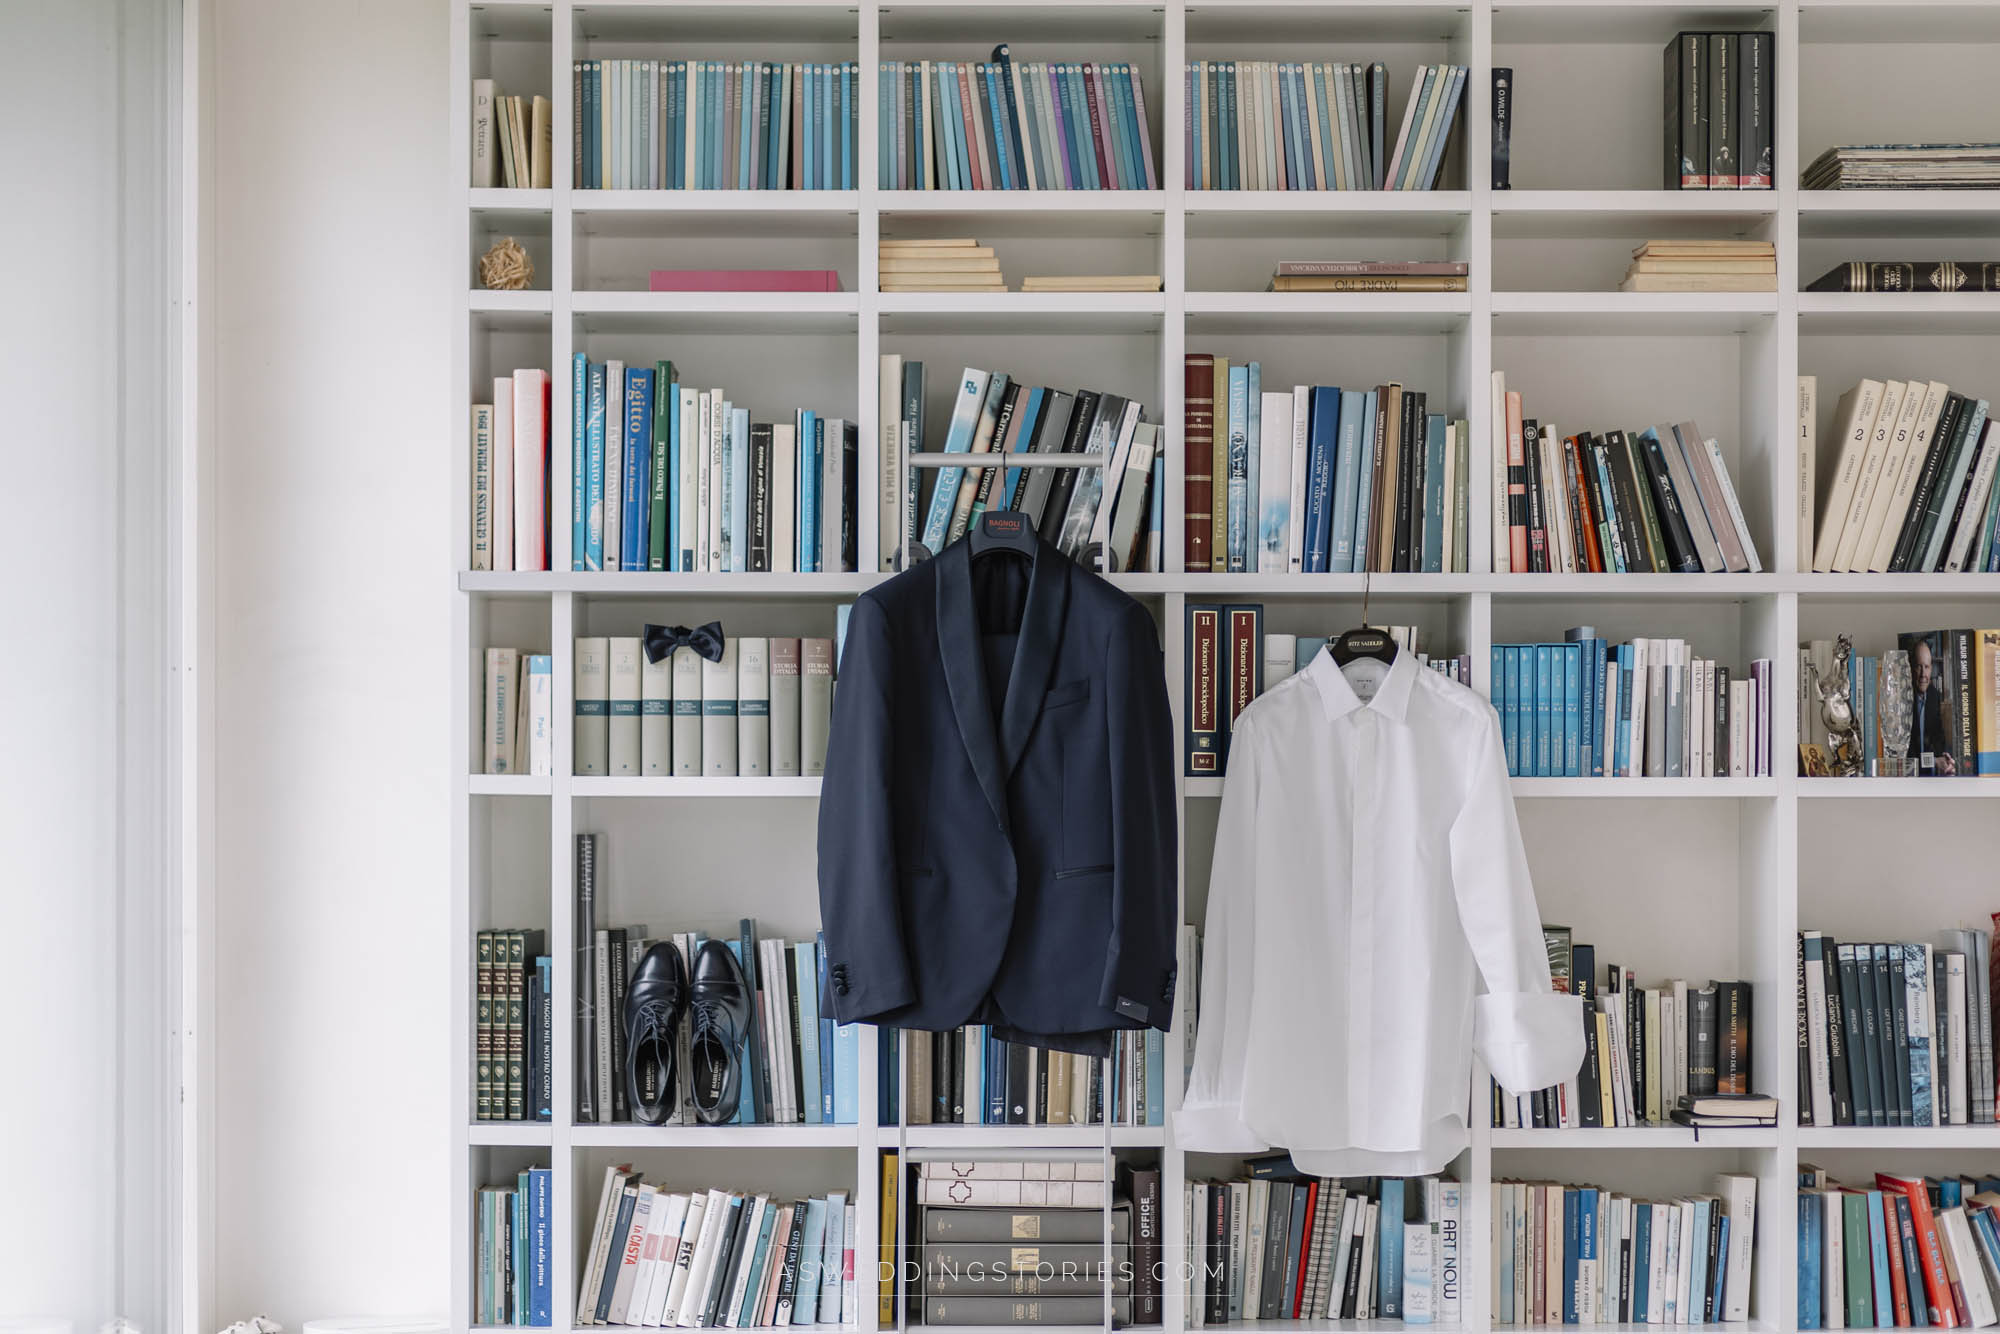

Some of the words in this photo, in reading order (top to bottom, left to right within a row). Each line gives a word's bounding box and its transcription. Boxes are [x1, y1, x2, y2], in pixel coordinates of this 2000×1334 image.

[1086, 82, 1100, 136] MICHELANGELO
[1497, 90, 1506, 119] O.WILDE
[1334, 280, 1356, 292] PIO
[1360, 280, 1399, 292] PADRE
[592, 371, 602, 420] ATLANTE
[628, 377, 648, 433] Egitto
[476, 410, 488, 431] 1994
[713, 403, 722, 428] CORSI
[989, 411, 1010, 455] Carneval
[1801, 425, 1807, 438] 1
[1854, 428, 1864, 441] 2
[1876, 428, 1885, 441] 3
[1897, 429, 1907, 442] 5
[1917, 429, 1926, 442] 4
[476, 433, 488, 473] PRIMATI
[590, 421, 601, 482] ILLUSTRATO
[885, 424, 896, 466] VENEZIA
[1314, 445, 1324, 475] MODENA
[476, 475, 488, 492] DEI
[885, 468, 895, 488] MIA
[885, 491, 895, 504] LA
[1312, 486, 1321, 514] DUCATO
[476, 493, 488, 540] GUINNESS
[988, 519, 1021, 528] BAGNOLI
[476, 543, 488, 552] IL
[1201, 615, 1211, 626] II
[1241, 615, 1247, 626] I
[1201, 637, 1210, 675] Dizionario
[1240, 637, 1249, 675] Dizionario
[1959, 635, 1968, 657] WILBUR
[1960, 659, 1968, 680] SMITH
[1201, 676, 1210, 725] Enciclopedico
[1239, 676, 1249, 711] Enciclope
[1961, 691, 1970, 716] GIORNO
[1582, 689, 1592, 745] ADOLESCENZA
[1963, 717, 1971, 738] DELLA
[1963, 738, 1972, 757] TIGRE
[1846, 966, 1851, 974] 1
[1862, 966, 1868, 974] 2
[1894, 965, 1903, 973] 15
[543, 998, 551, 1028] VIAGGIO
[1828, 994, 1838, 1023] Luciano
[1730, 1016, 1738, 1036] SMITH
[1798, 1014, 1809, 1048] DIMORE
[543, 1030, 551, 1045] NEL
[1830, 1024, 1842, 1058] Giubbilei
[543, 1046, 551, 1072] NOSTRO
[1730, 1047, 1738, 1059] DIO
[1730, 1060, 1738, 1073] DEL
[543, 1074, 551, 1100] CORPO
[538, 1176, 546, 1198] PHILIPPE
[1140, 1197, 1150, 1238] OFFICE
[1584, 1213, 1592, 1237] NERUDA
[537, 1229, 546, 1246] gioco
[789, 1230, 800, 1251] GENI
[1443, 1219, 1458, 1251] ART
[1927, 1231, 1938, 1248] BLA
[538, 1247, 546, 1263] della
[624, 1235, 643, 1265] CASTA
[787, 1251, 797, 1263] DA
[1584, 1239, 1592, 1258] PABLO
[1931, 1249, 1942, 1268] BLA
[537, 1264, 546, 1286] pittura
[1443, 1257, 1458, 1300] NOW
[1582, 1265, 1590, 1291] D'AMORE
[1936, 1269, 1946, 1286] BLA
[1431, 1280, 1439, 1306] TIROIDE
[1582, 1292, 1590, 1314] POESIA
